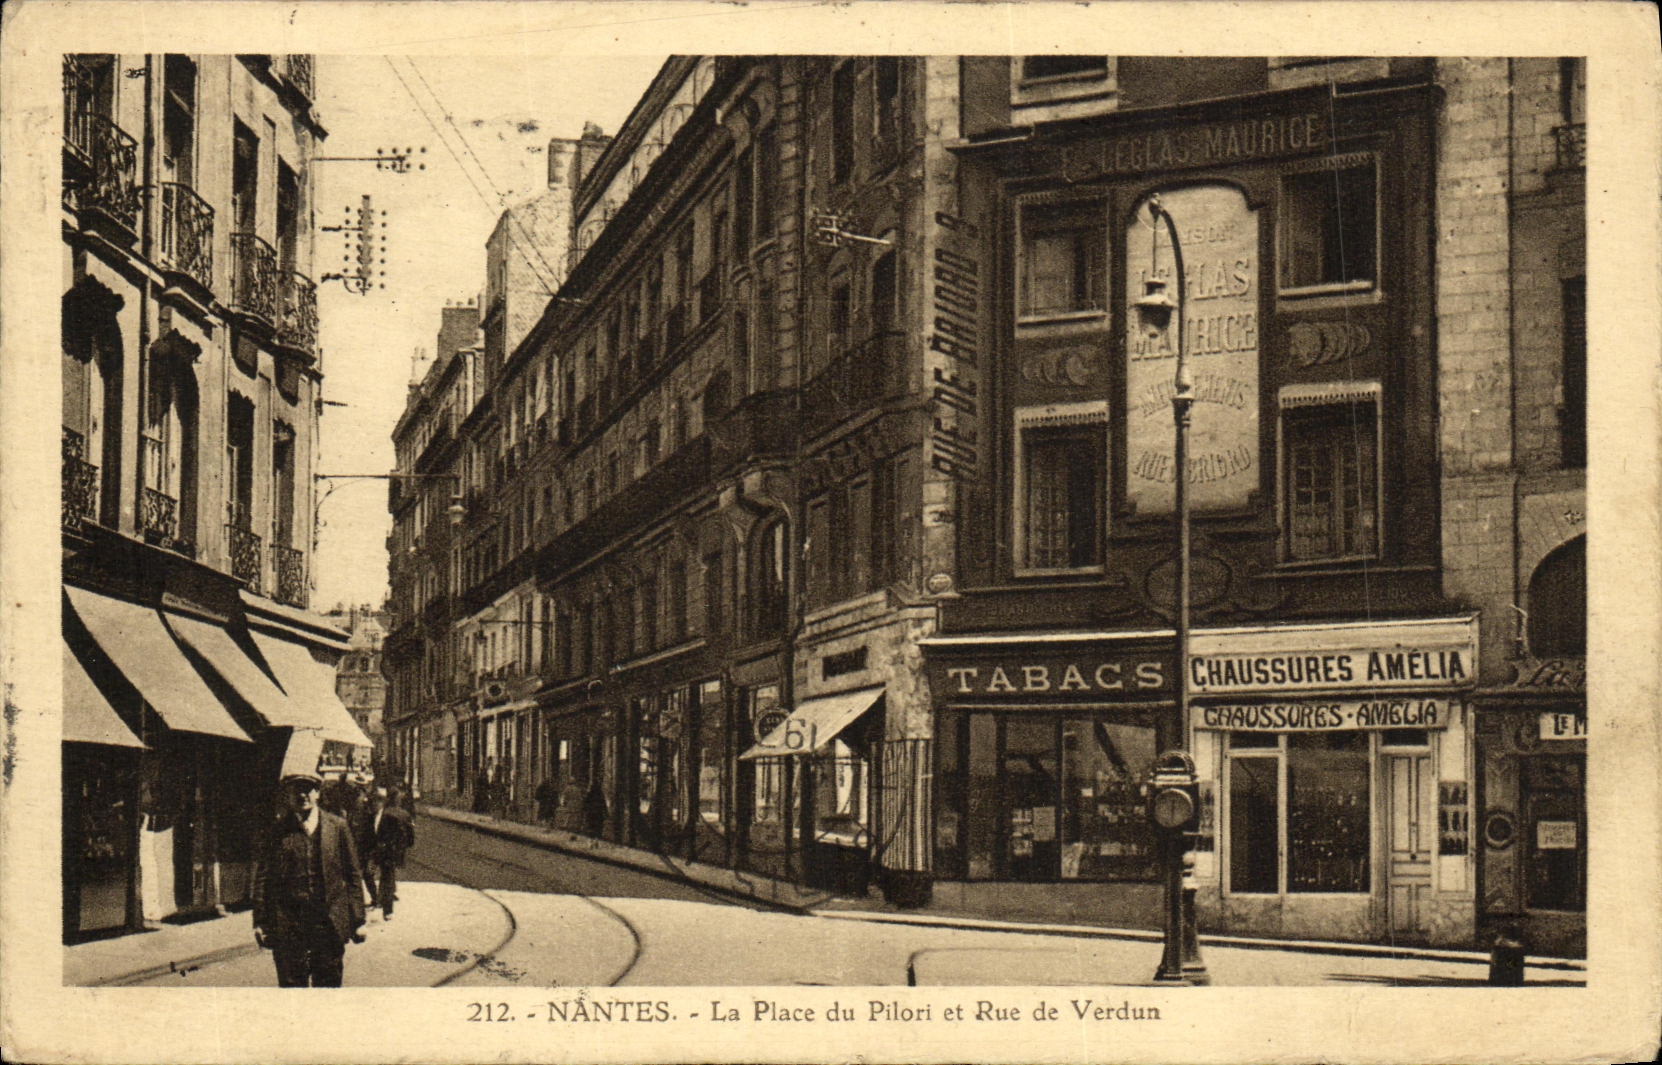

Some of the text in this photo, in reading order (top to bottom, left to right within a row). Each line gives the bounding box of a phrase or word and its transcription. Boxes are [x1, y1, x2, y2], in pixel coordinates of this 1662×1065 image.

[1205, 112, 1320, 160] MAURICE
[930, 248, 979, 369] BRIORD
[933, 367, 979, 418] DE
[931, 417, 979, 478] RUE
[947, 661, 1164, 693] TABACS
[1190, 648, 1466, 686] CHAUSSURES AMÉLIA
[1203, 701, 1438, 729] CHAUSSURES AMELIA
